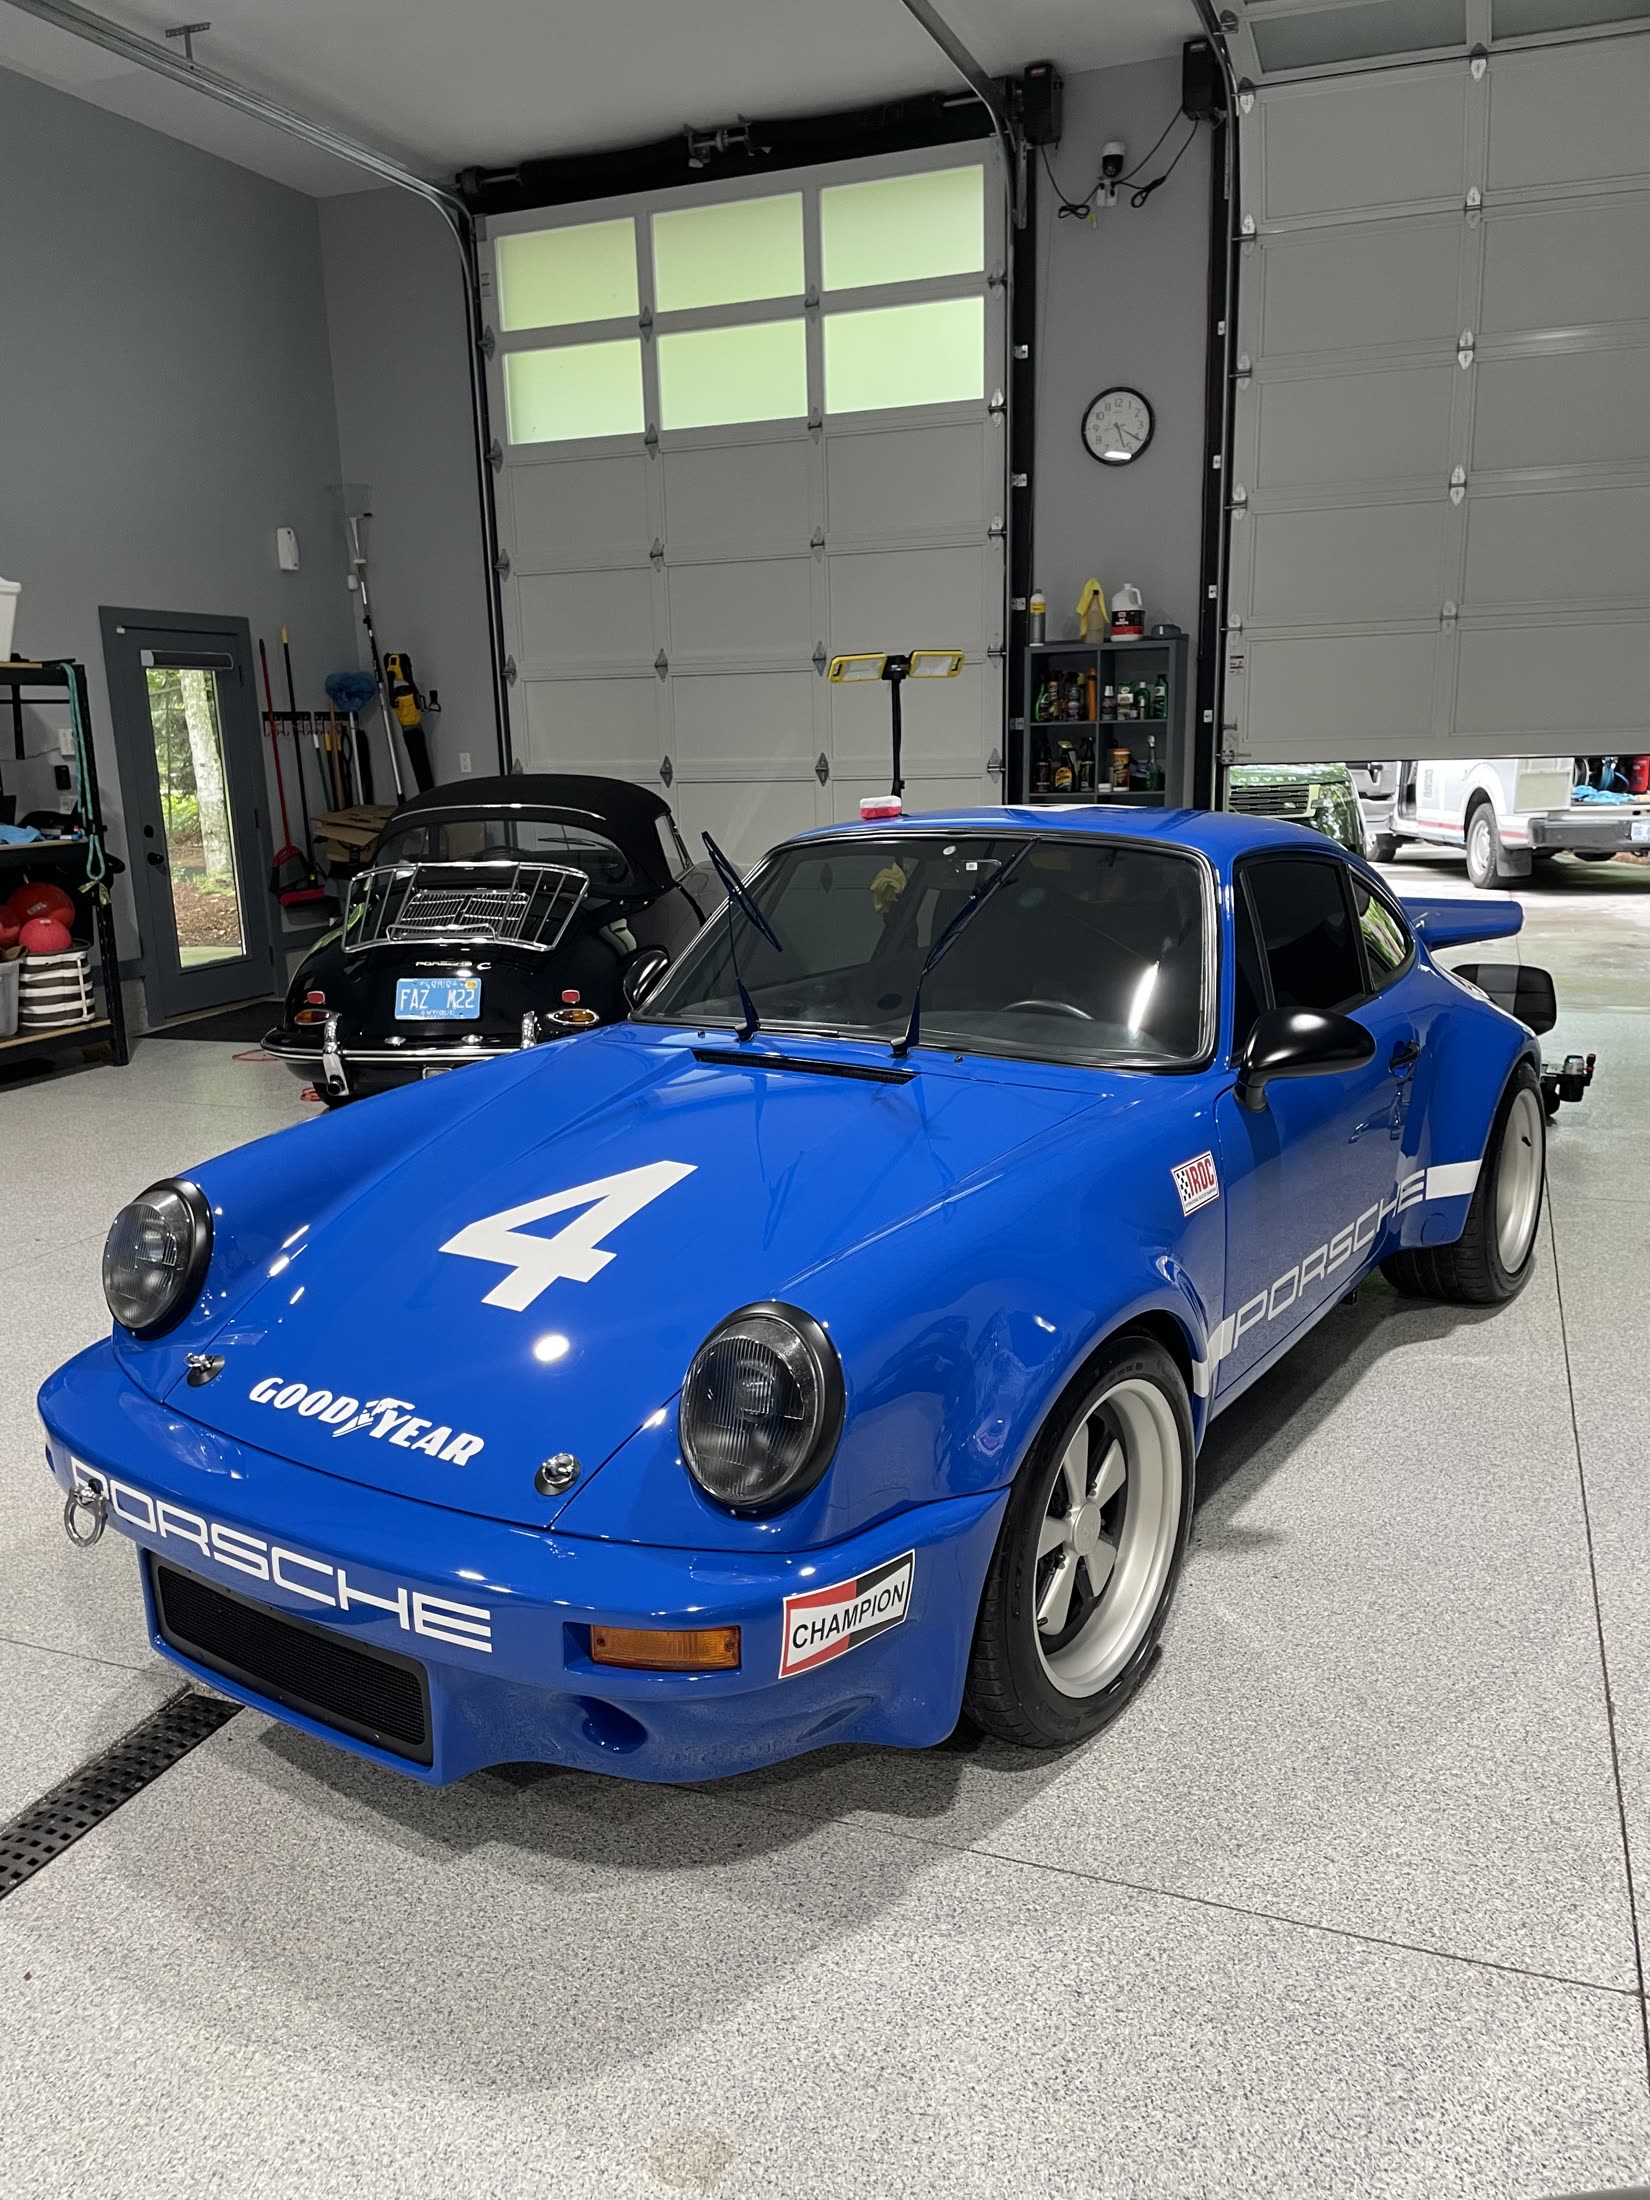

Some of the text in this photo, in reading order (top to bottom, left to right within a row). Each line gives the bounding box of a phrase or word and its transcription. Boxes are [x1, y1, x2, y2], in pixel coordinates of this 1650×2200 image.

[1104, 402, 1111, 412] 11
[1114, 398, 1123, 408] 12
[1095, 411, 1104, 421] 10
[1135, 408, 1141, 418] 2
[1092, 424, 1099, 433] 9
[1138, 420, 1144, 430] 3
[1096, 435, 1102, 445] 8
[420, 980, 458, 989] FLORIDA
[400, 988, 430, 1010] FAZ
[1185, 1158, 1215, 1197] IROC
[438, 1160, 699, 1312] 4
[1233, 1169, 1425, 1349] PORSCHE
[70, 1456, 493, 1653] PORSCHE
[792, 1581, 905, 1649] CHAMPION
